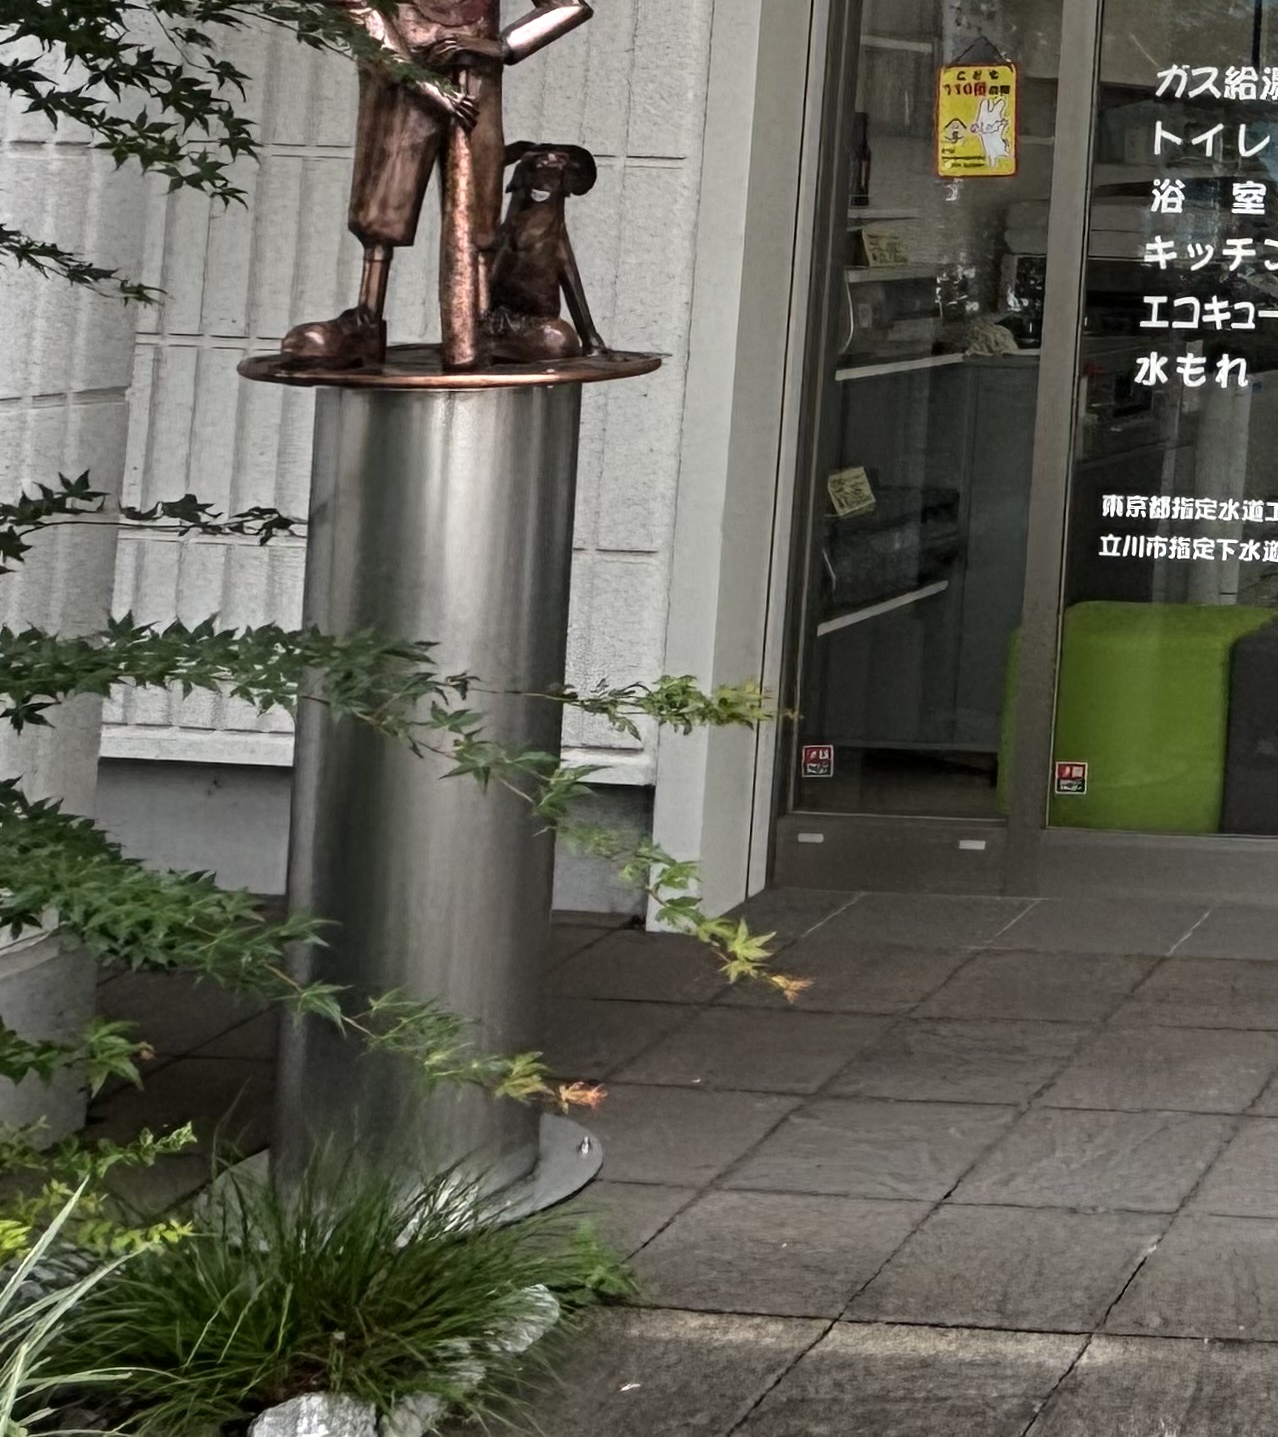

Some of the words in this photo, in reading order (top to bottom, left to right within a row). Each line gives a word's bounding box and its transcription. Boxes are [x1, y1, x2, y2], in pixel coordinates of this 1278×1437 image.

[1152, 120, 1270, 157] トイレ
[1134, 351, 1249, 389] 水もれ
